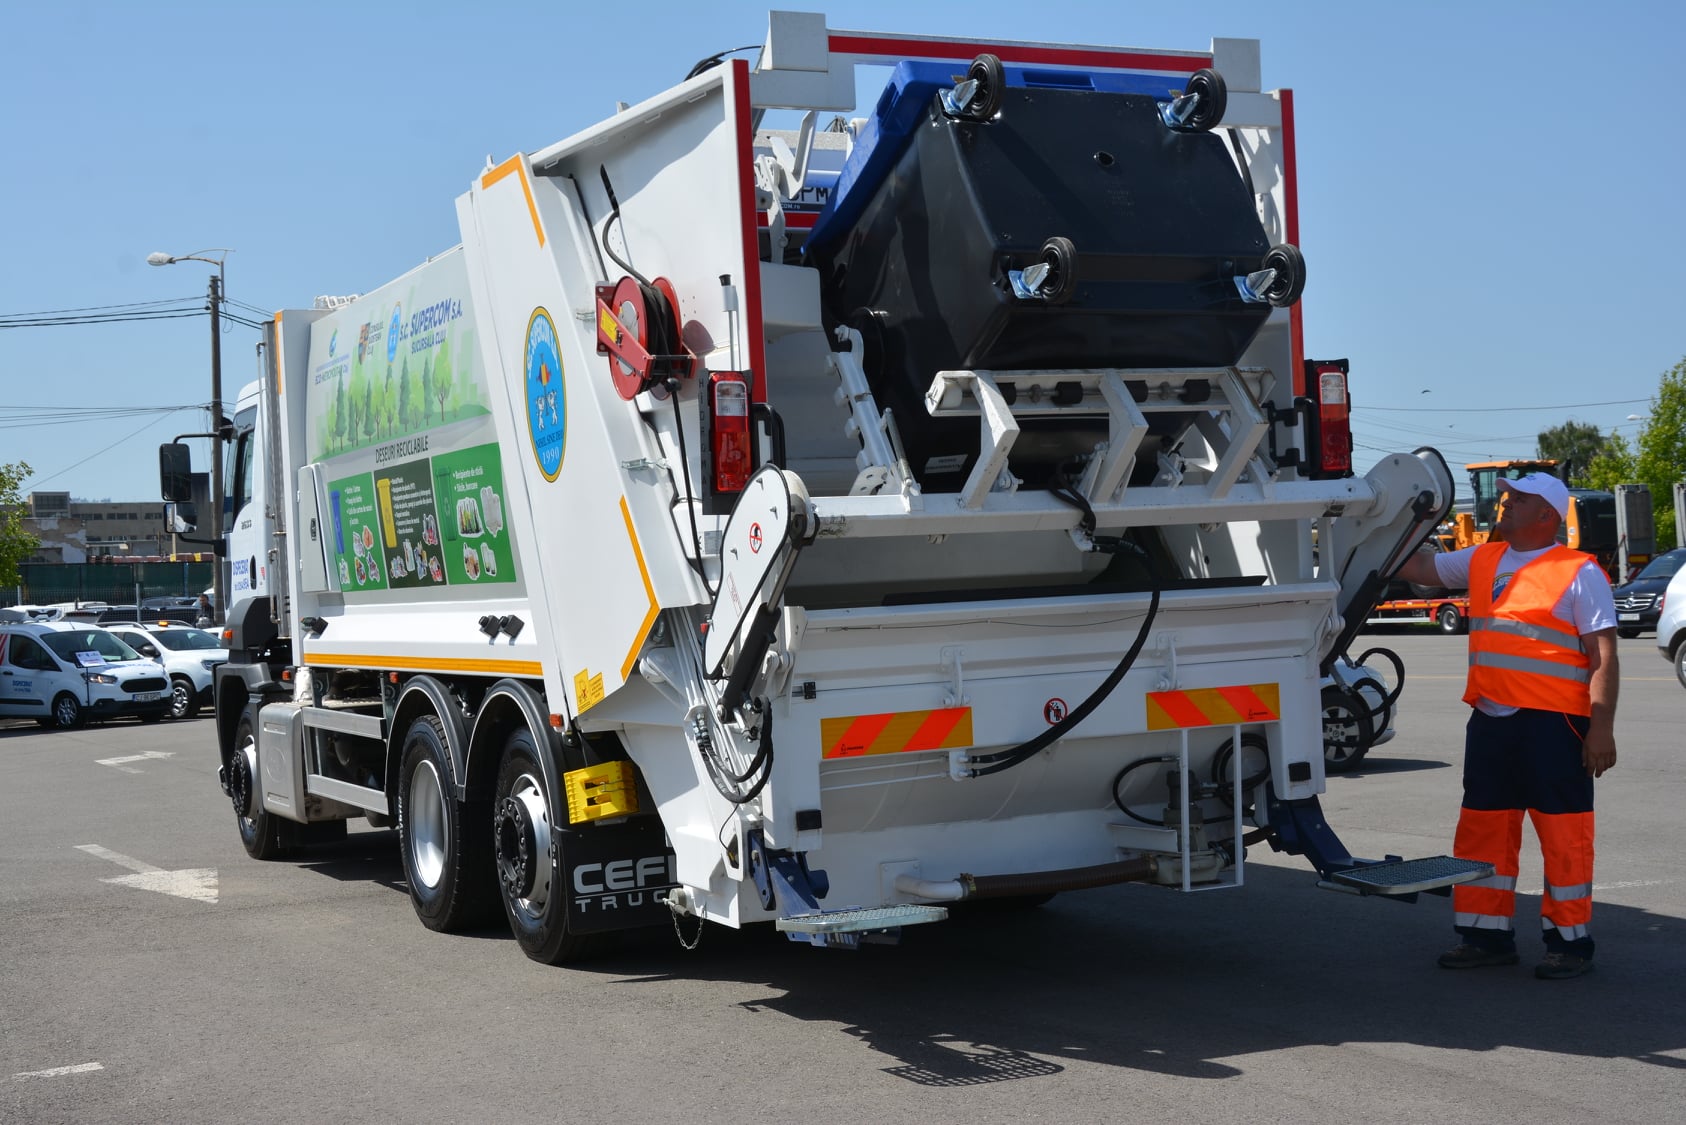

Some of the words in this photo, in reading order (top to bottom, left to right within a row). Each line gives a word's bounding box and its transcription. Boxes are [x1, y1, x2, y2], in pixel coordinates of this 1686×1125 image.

[410, 298, 451, 336] SUPERCOM
[452, 299, 462, 320] S.A.
[396, 435, 428, 458] RECICLABILE
[541, 446, 560, 465] 1990
[573, 854, 677, 894] CEFI
[574, 889, 667, 913] TRUC
